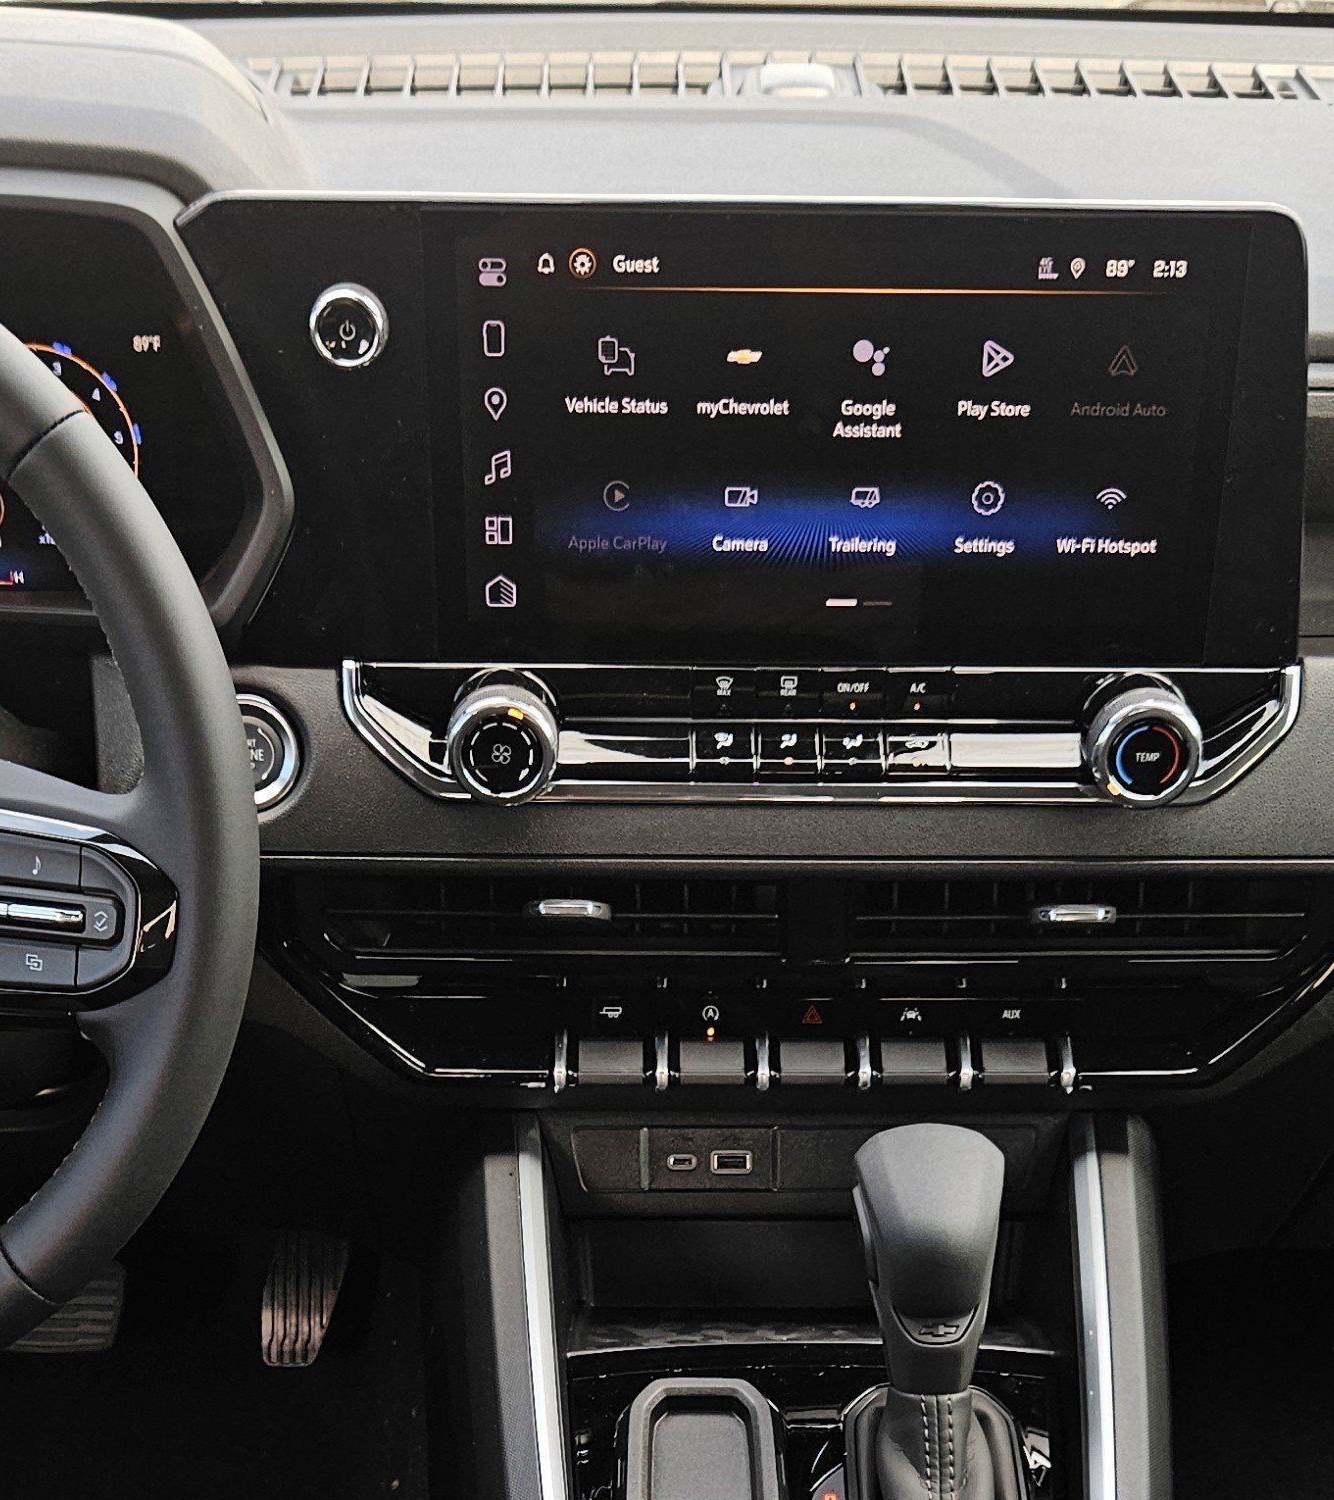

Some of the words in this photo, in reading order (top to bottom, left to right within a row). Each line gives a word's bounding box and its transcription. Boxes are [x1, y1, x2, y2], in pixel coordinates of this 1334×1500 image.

[612, 254, 660, 274] Guest
[1152, 259, 1188, 278] 2:13
[91, 387, 101, 401] 4
[565, 396, 619, 415] Vehicle
[621, 397, 669, 415] Status
[696, 398, 790, 418] myChevrolet
[840, 400, 897, 421] Google
[957, 401, 989, 421] Play
[990, 401, 1031, 418] Store
[1070, 401, 1130, 418] Android
[1132, 402, 1167, 418] Auto
[832, 421, 902, 439] Assistant
[568, 536, 609, 553] Apple
[612, 536, 667, 554] CarPlay
[712, 534, 768, 552] Camera
[828, 536, 896, 557] Trailering
[954, 536, 1015, 557] Settings
[1056, 538, 1096, 554] Wi-Fi
[1097, 538, 1158, 557] Hotspot
[837, 682, 870, 693] ON/OFF
[909, 682, 926, 693] A/C
[1135, 752, 1160, 763] TEMP
[1002, 1009, 1021, 1019] AUX
